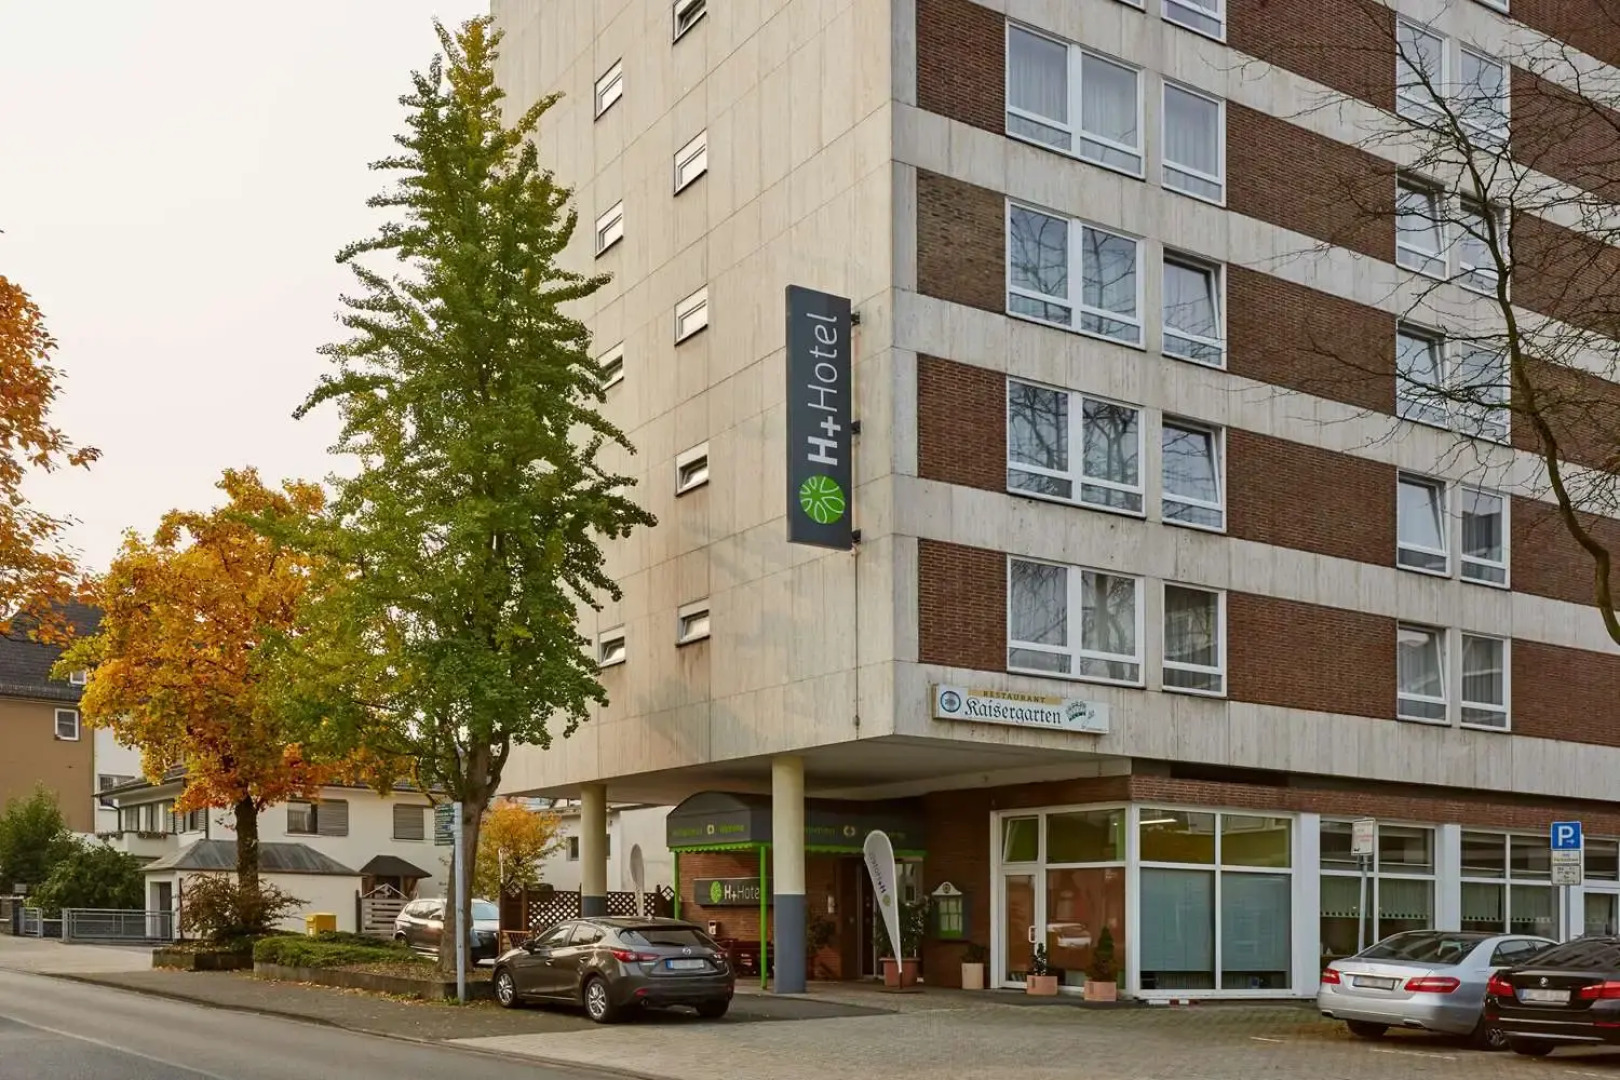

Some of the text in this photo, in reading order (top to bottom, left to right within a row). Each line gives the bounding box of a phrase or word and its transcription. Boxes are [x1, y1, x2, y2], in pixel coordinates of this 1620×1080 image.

[806, 313, 841, 466] H+Hotel
[983, 690, 1046, 704] RESTAURANT
[964, 697, 1061, 724] Kaisergarten
[1558, 825, 1574, 846] P
[724, 883, 760, 902] H+Hote
